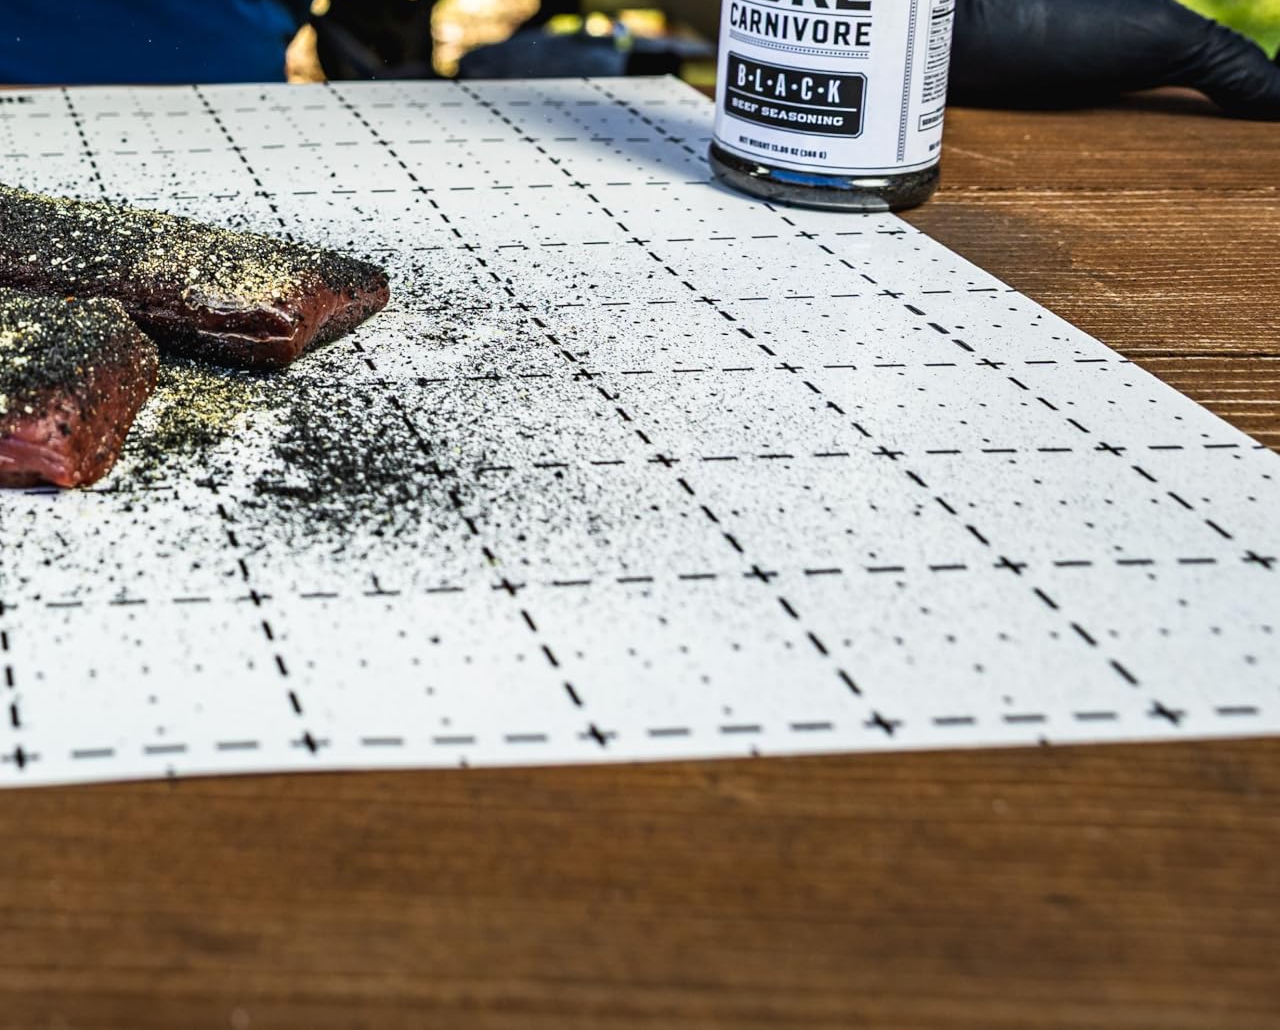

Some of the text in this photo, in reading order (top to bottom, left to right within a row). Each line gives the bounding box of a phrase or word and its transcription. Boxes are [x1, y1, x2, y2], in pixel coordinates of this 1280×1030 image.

[730, 2, 872, 46] CARNIVORE
[732, 97, 844, 126] BEEF SEASONING
[749, 138, 770, 149] WEIGHT
